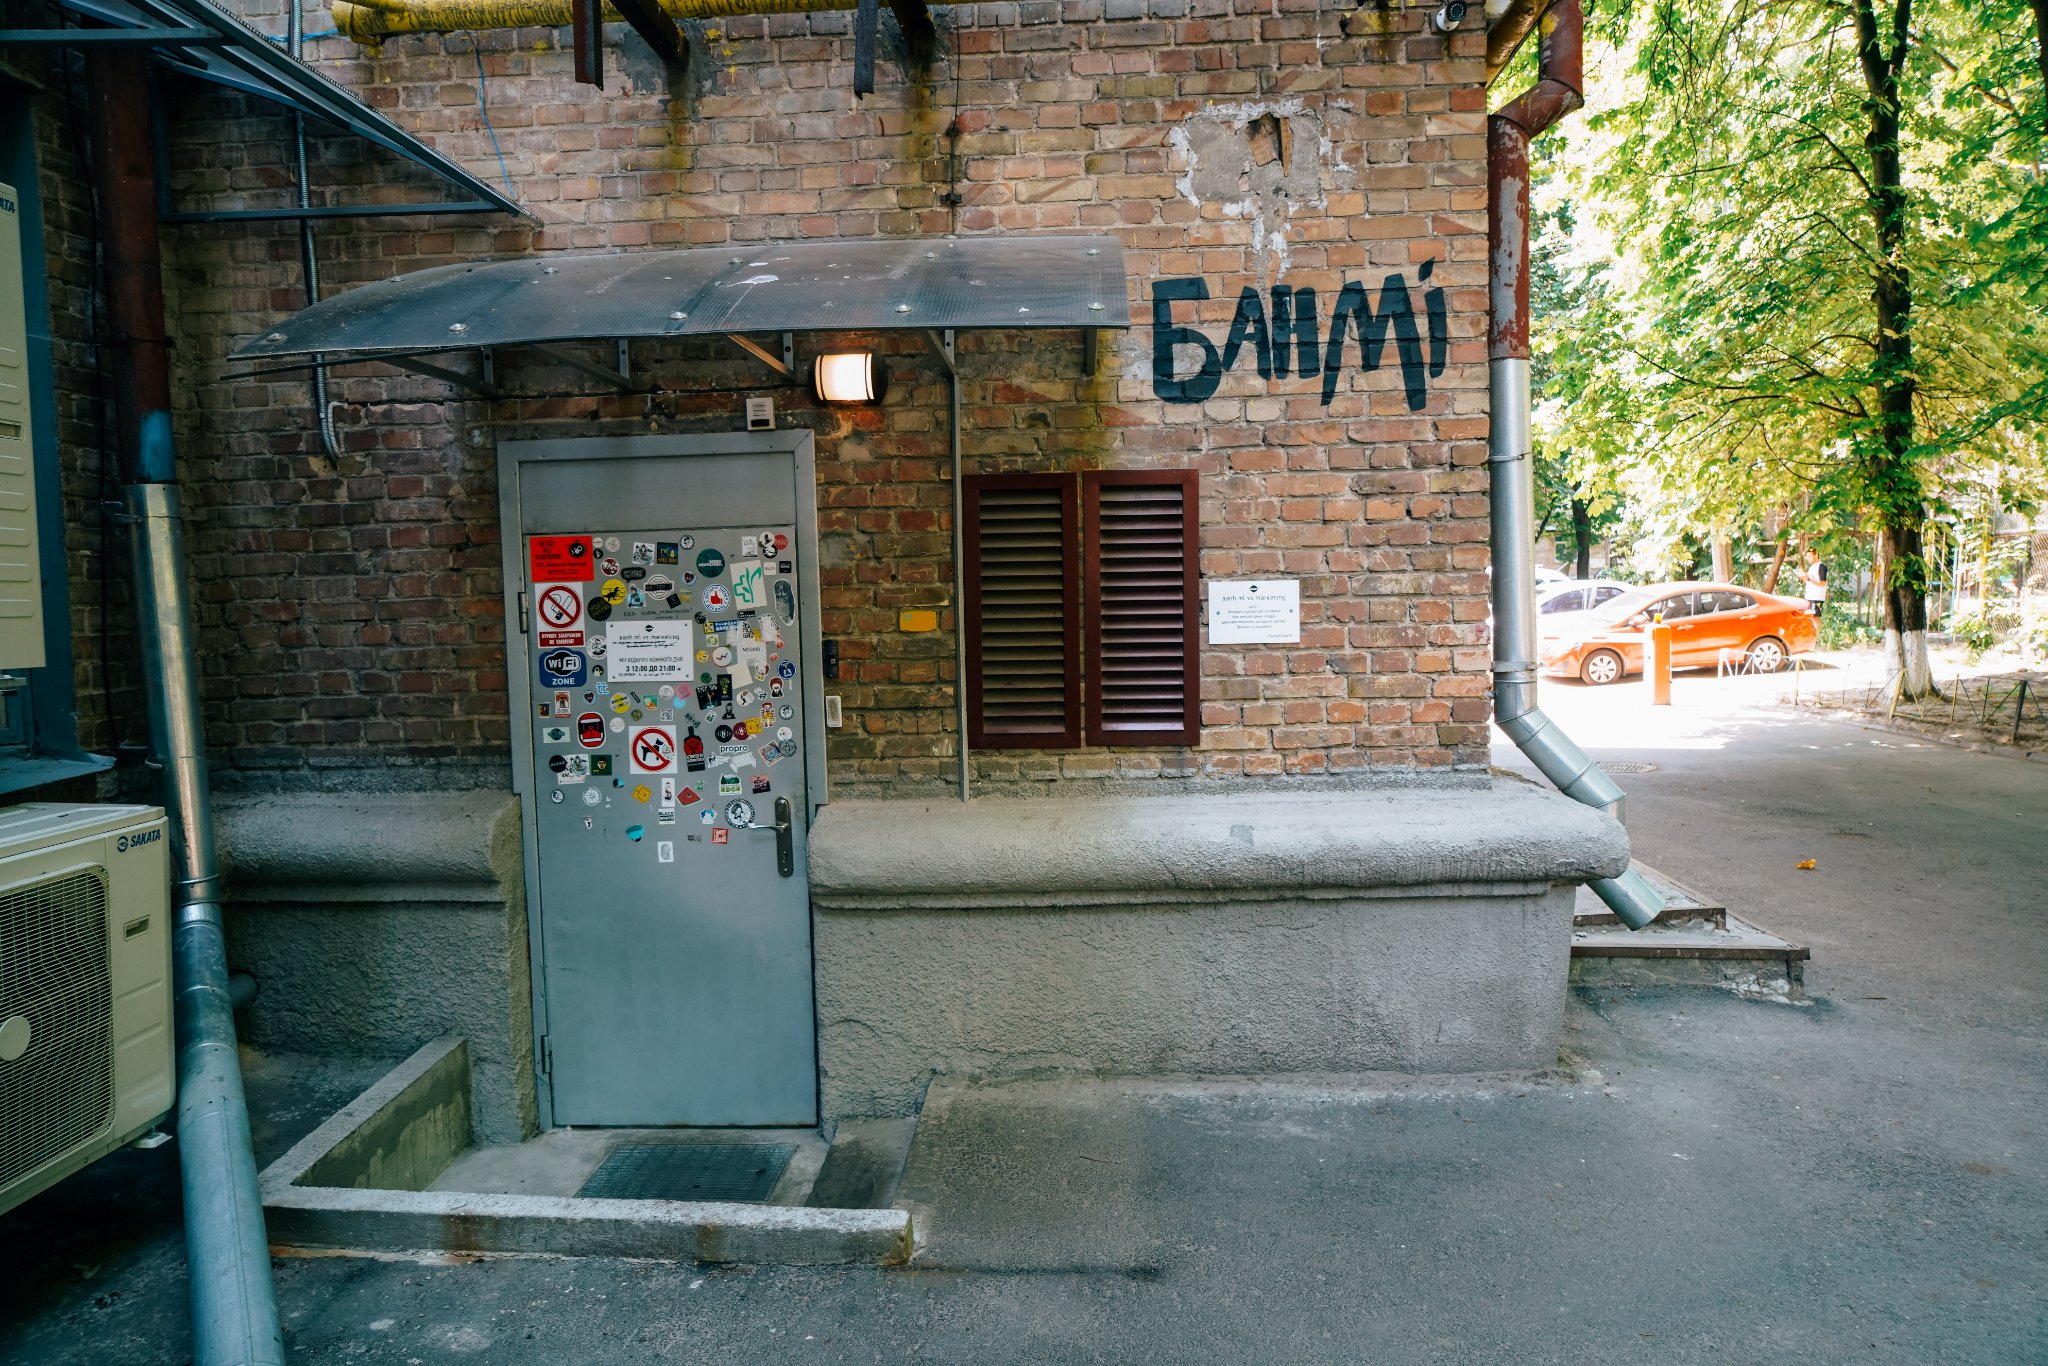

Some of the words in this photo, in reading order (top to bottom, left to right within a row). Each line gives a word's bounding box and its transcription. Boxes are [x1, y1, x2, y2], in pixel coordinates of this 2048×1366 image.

[552, 677, 576, 685] ZONE
[720, 745, 748, 754] propro
[130, 828, 161, 847] SAKATA
